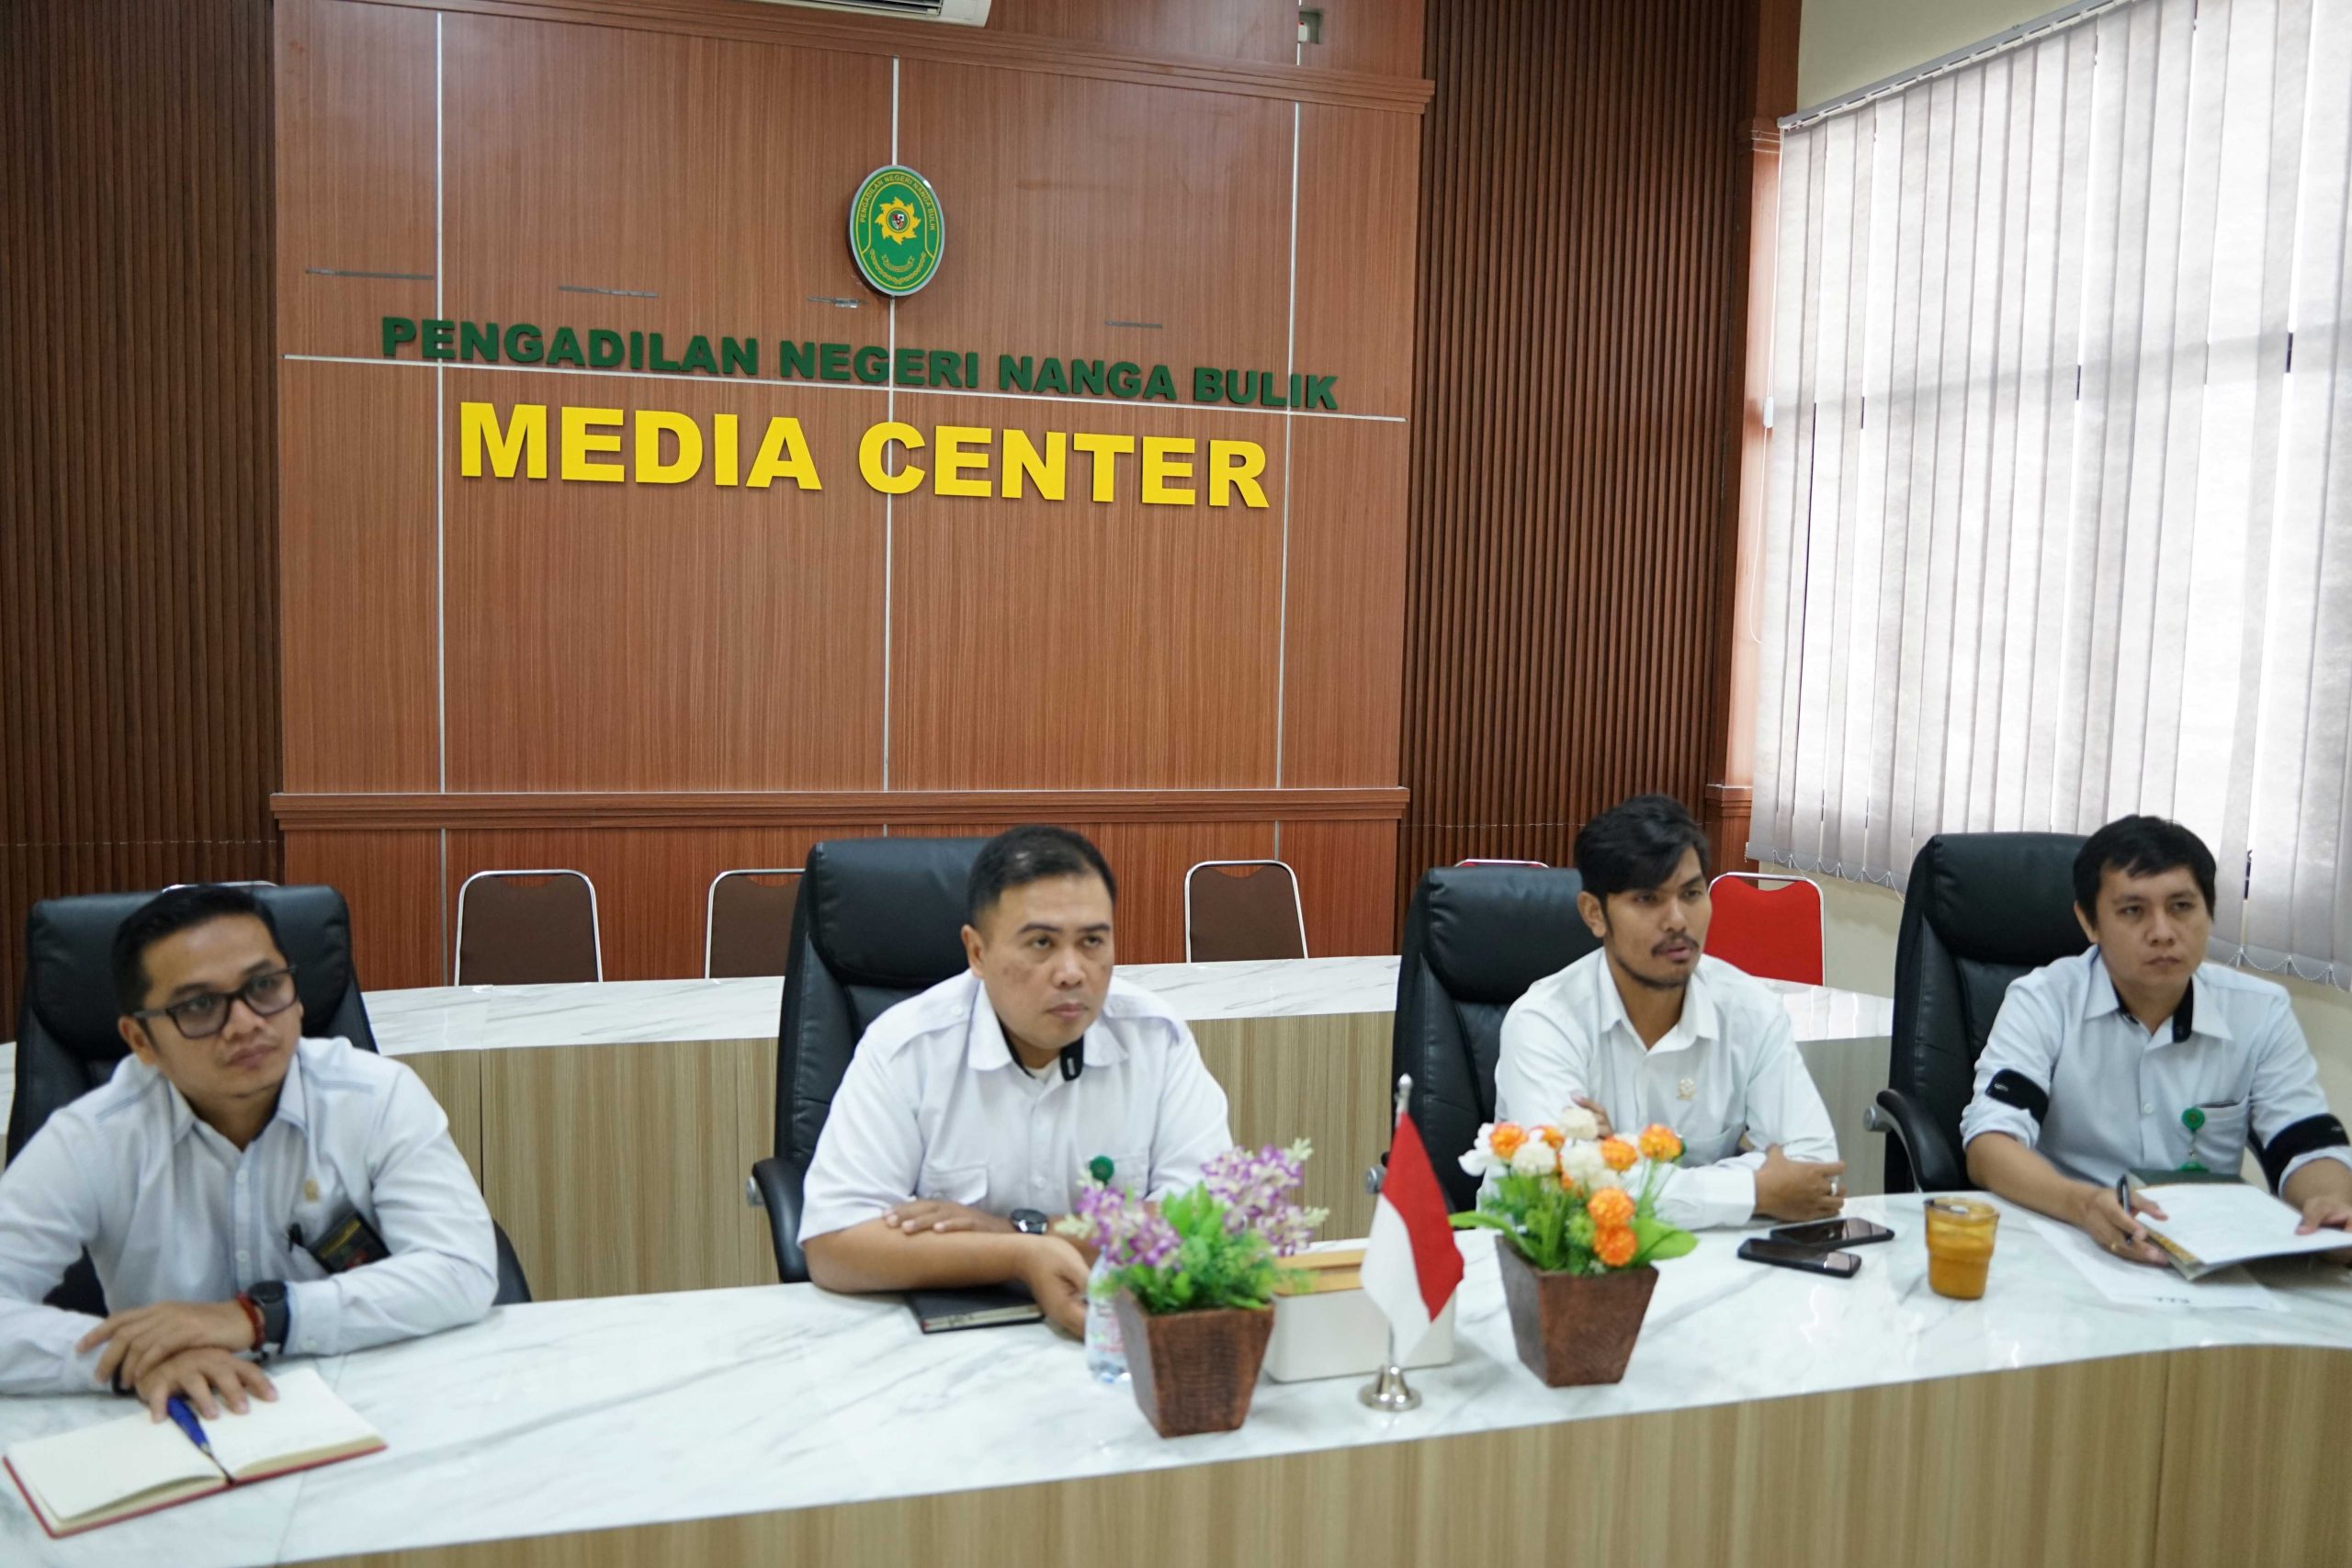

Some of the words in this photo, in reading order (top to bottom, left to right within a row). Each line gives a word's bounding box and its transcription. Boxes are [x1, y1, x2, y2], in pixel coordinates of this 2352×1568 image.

[859, 181, 884, 223] PENGADILAN
[884, 175, 912, 185] NEGERI
[912, 182, 932, 208] NANGA
[927, 207, 936, 231] BULIK
[381, 316, 758, 376] PENGADILAN
[780, 341, 978, 389] NEGERI
[999, 355, 1177, 400] NANGA
[1193, 367, 1338, 411] BULIK
[460, 401, 822, 491] MEDIA
[858, 421, 1270, 509] CENTER
